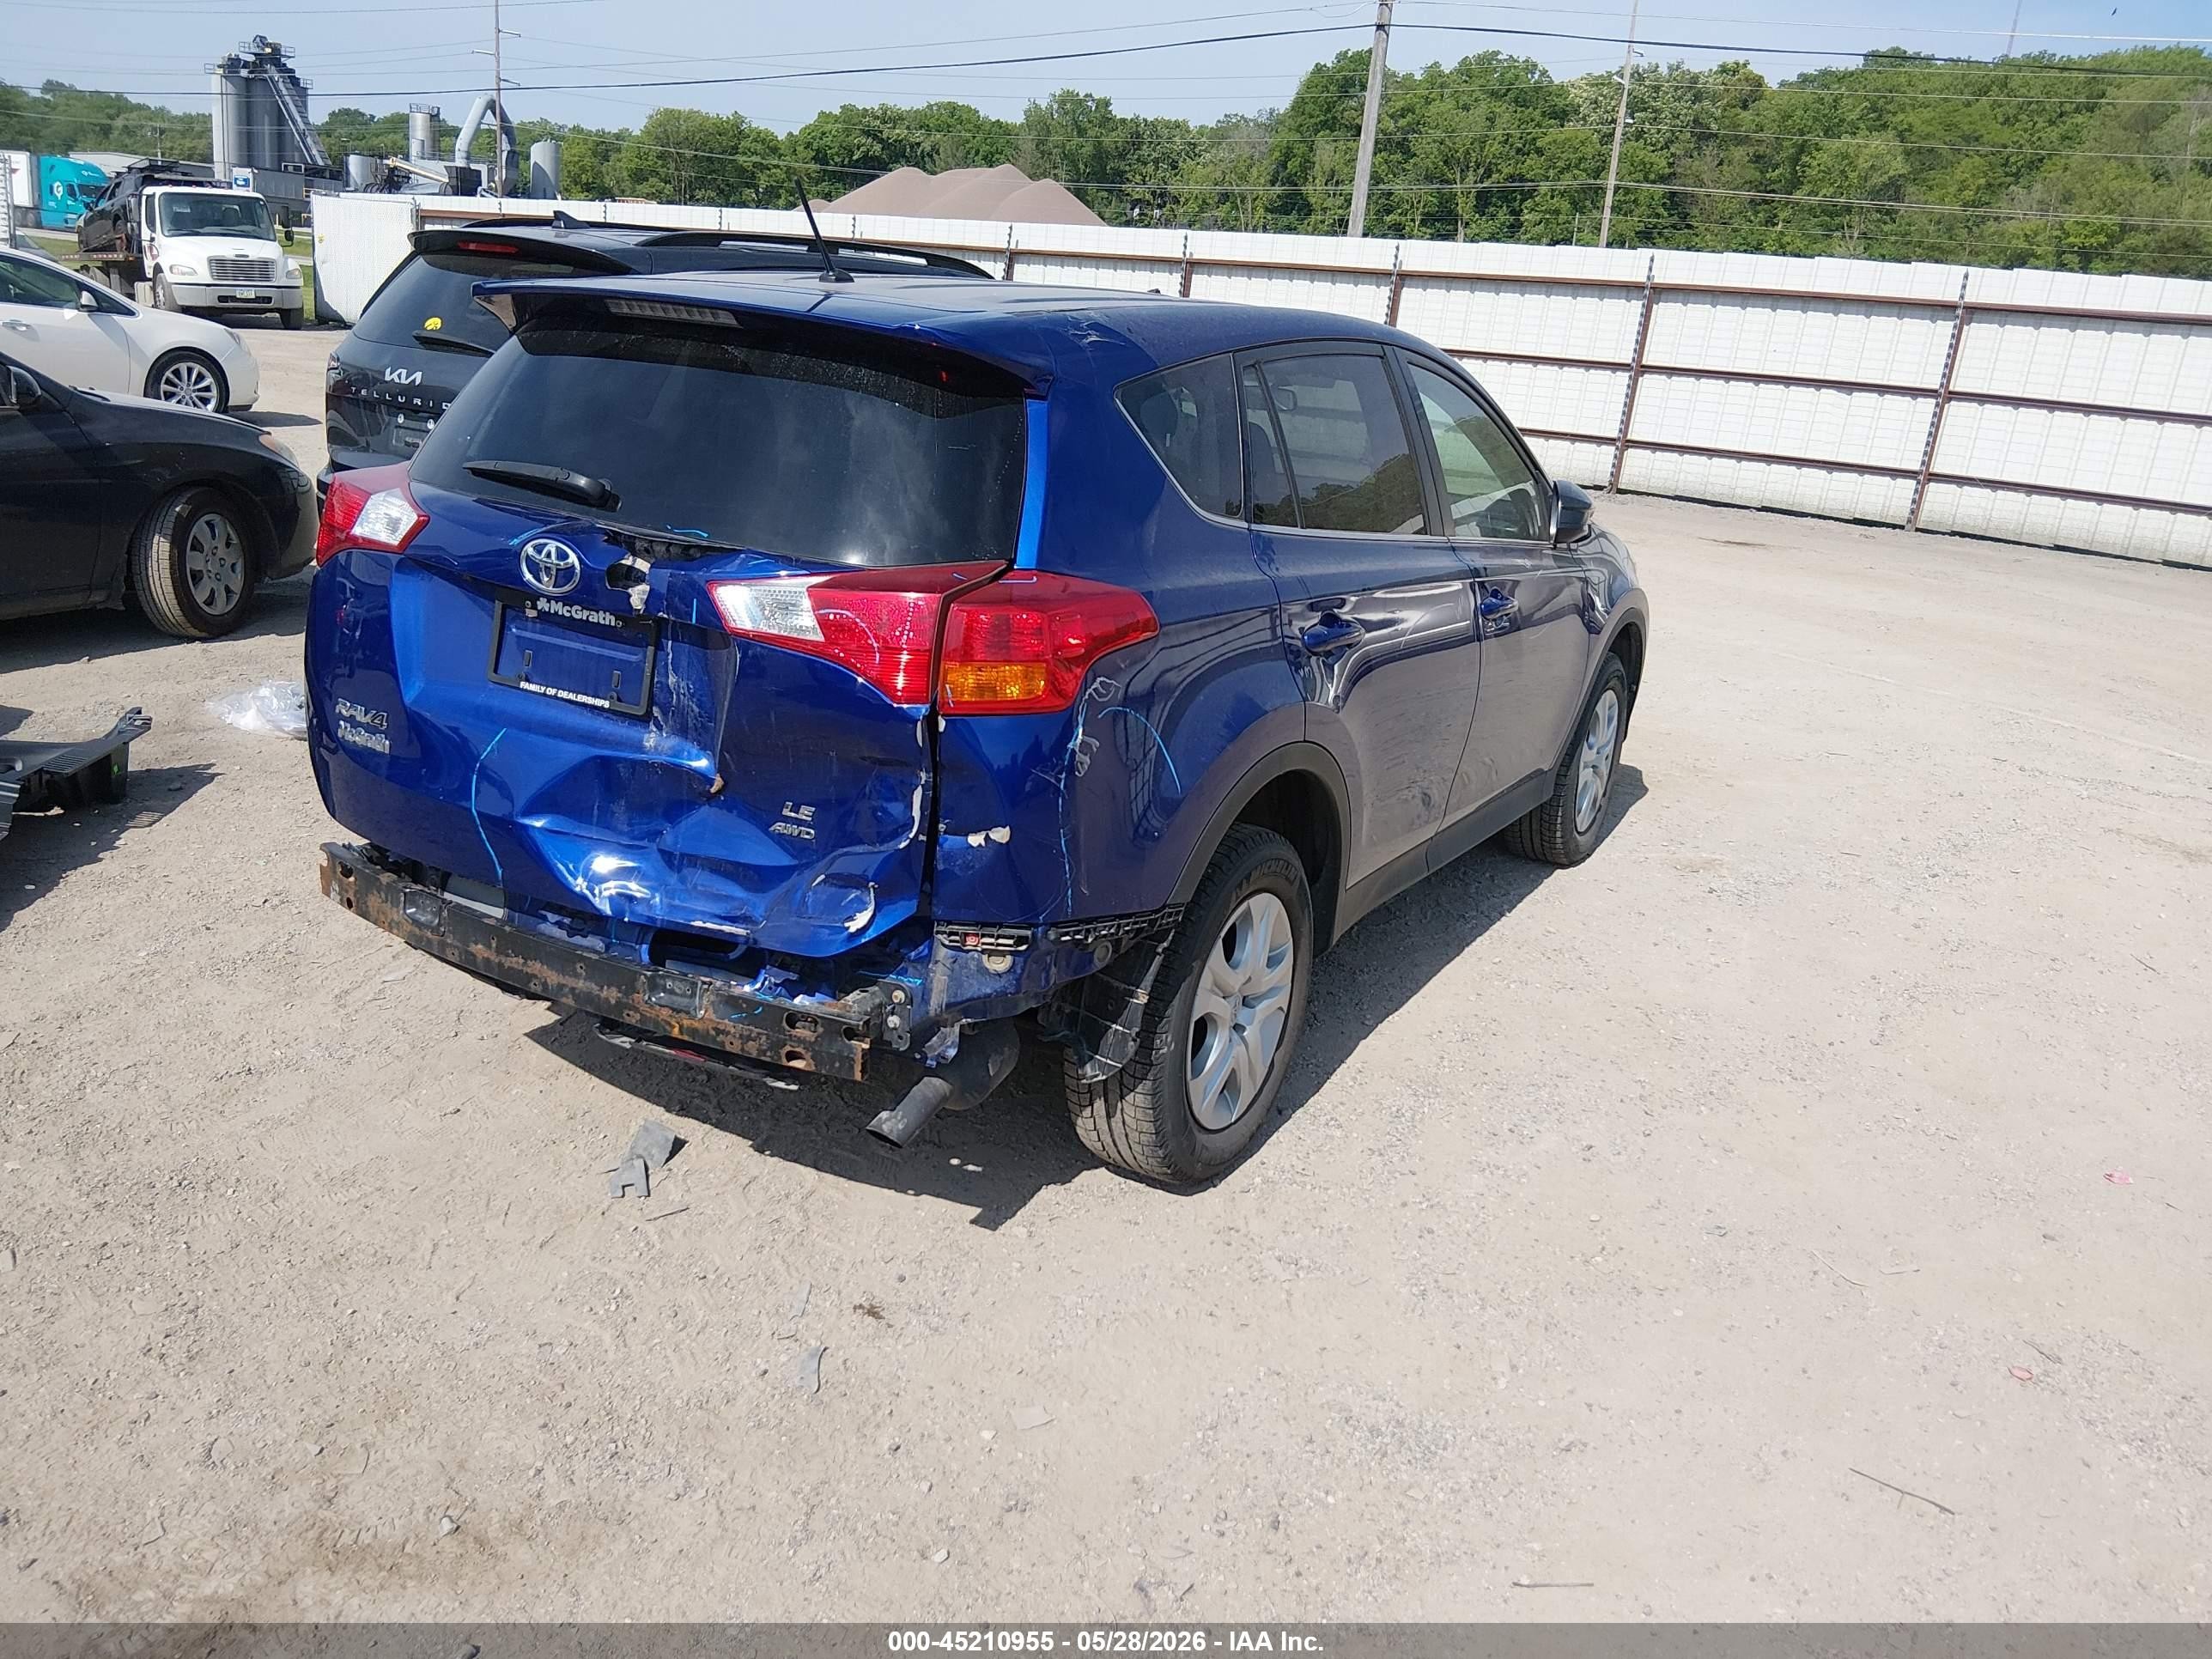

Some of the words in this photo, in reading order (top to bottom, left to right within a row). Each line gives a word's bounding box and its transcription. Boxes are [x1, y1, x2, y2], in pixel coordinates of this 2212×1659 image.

[385, 367, 422, 386] KIA
[550, 600, 616, 626] McGrath
[520, 681, 545, 693] FAMILY
[546, 687, 558, 696] OF
[557, 690, 610, 708] DEALERSHIPS
[335, 697, 388, 730] RAV4
[782, 801, 816, 821] LE
[769, 822, 815, 840] AWD
